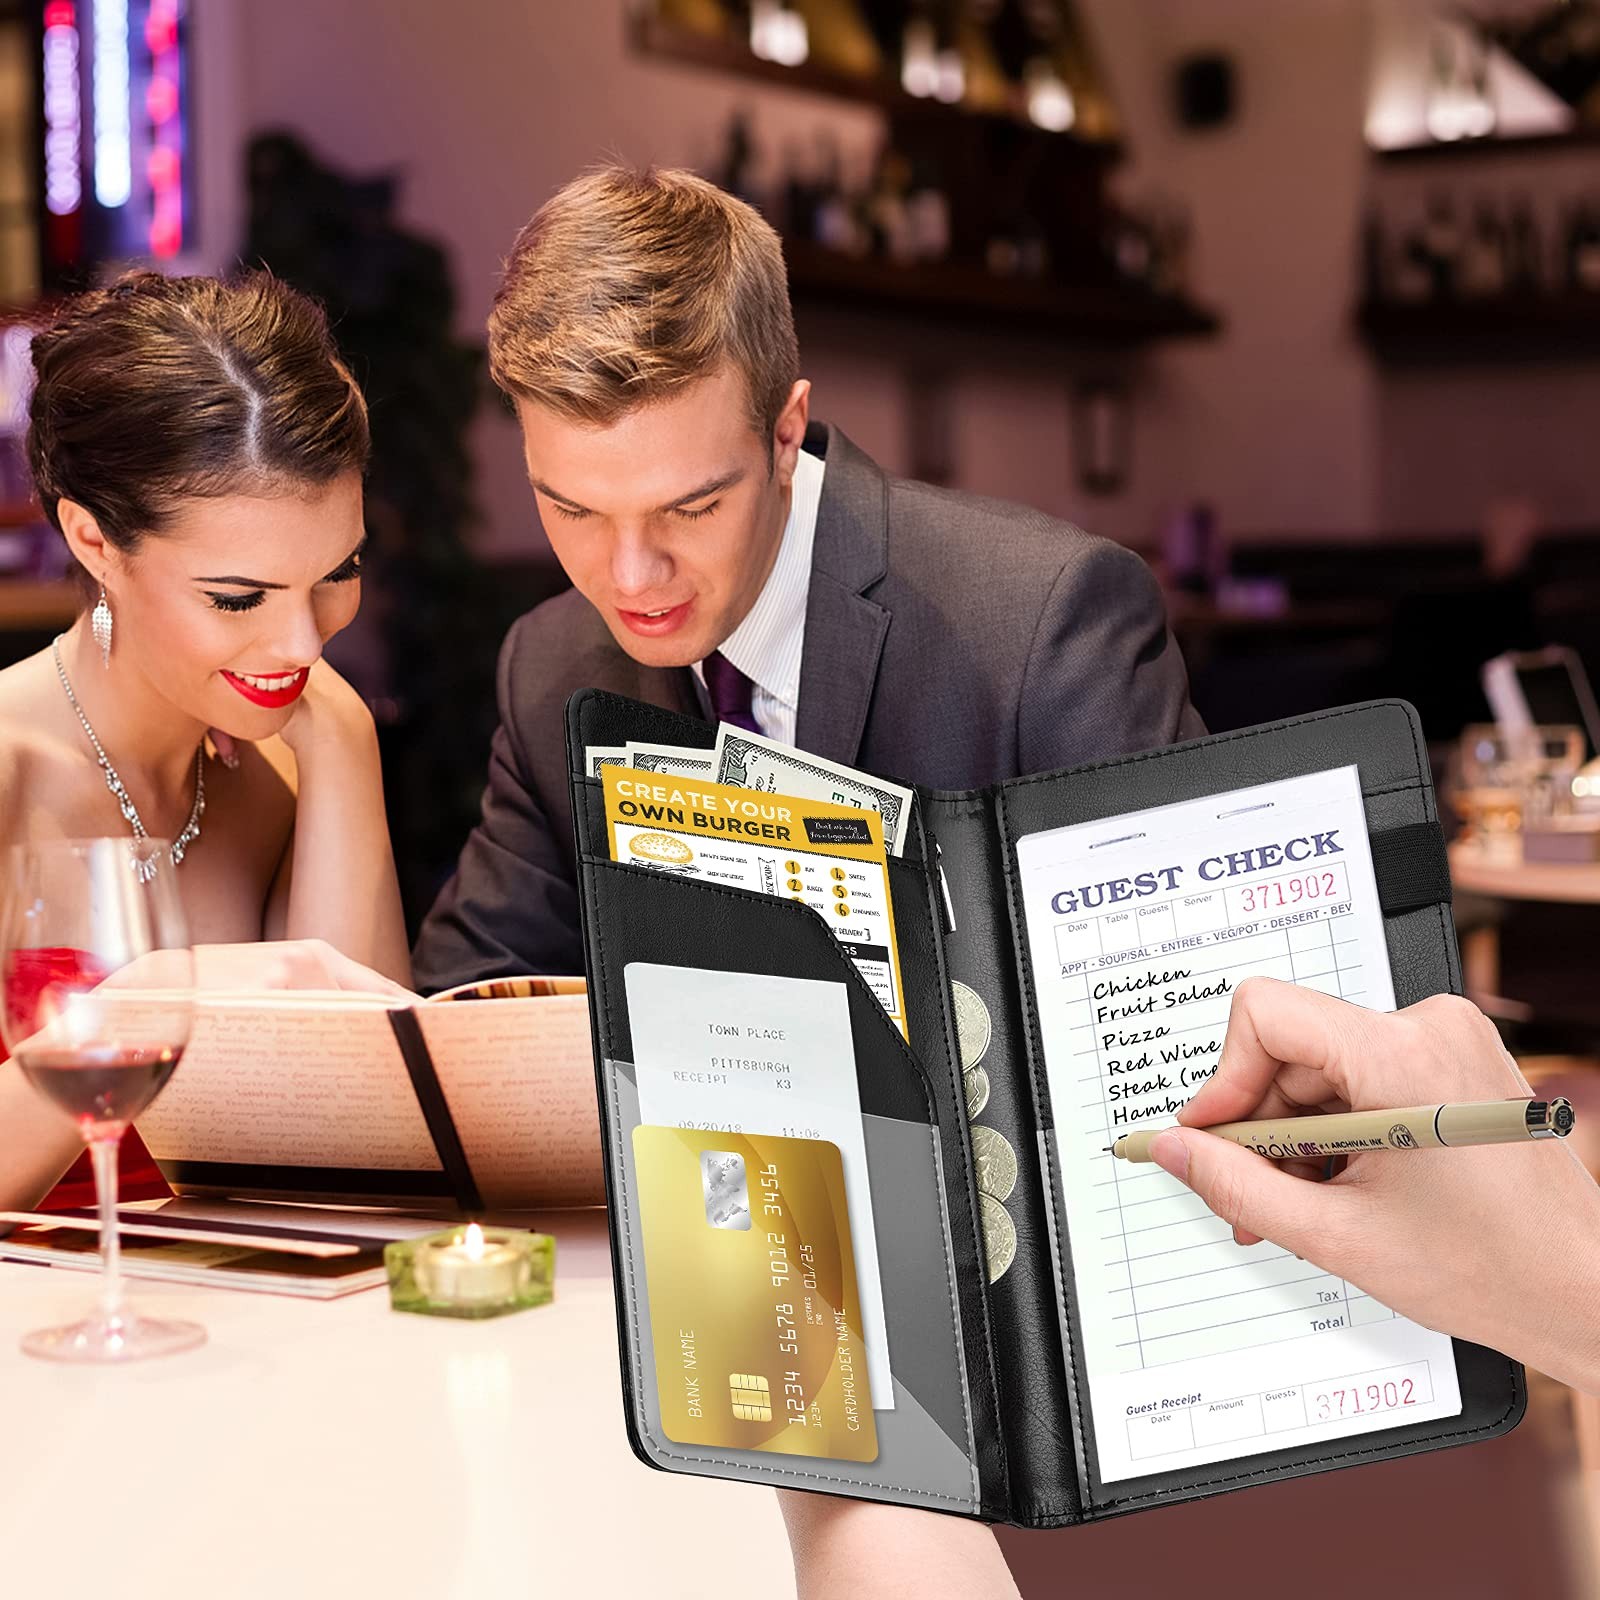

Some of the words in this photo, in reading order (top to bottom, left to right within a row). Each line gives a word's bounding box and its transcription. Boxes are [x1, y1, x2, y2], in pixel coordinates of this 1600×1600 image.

[616, 780, 718, 810] CREATE
[723, 797, 792, 823] YOUR
[618, 800, 685, 825] OWN
[693, 812, 792, 842] BURGER
[790, 861, 796, 874] 1
[835, 867, 843, 881] 4
[1051, 865, 1184, 915] GUEST
[1198, 829, 1345, 881] CHECK
[791, 879, 801, 892] 2
[836, 885, 844, 898] 5
[1240, 872, 1337, 912] 371902
[839, 903, 847, 917] 6
[1138, 904, 1170, 917] Guests
[1183, 894, 1213, 907] Server
[1067, 922, 1088, 933] Date
[1105, 913, 1129, 925] Table
[1061, 960, 1088, 976] APPT
[1098, 948, 1152, 967] SOUP/SAL
[1161, 935, 1204, 953] ENTREE
[1213, 923, 1260, 941] VEG/POT
[1270, 909, 1320, 929] DESSERT
[1330, 902, 1352, 916] BEV
[1093, 969, 1191, 1000] Chicken
[1097, 996, 1158, 1024] Fruit
[1164, 978, 1233, 1008] Salad
[708, 1023, 740, 1037] TOWN
[747, 1027, 786, 1041] PLACE
[1102, 1026, 1171, 1051] Pizza
[711, 1057, 791, 1073] PITTSBURGH
[1107, 1052, 1154, 1076] Red
[1160, 1040, 1222, 1064] Wine
[673, 1071, 728, 1085] RECEIPT
[775, 1079, 792, 1090] K3
[1108, 1074, 1173, 1102] Steak
[1299, 1141, 1322, 1157] 005
[1331, 1139, 1368, 1149] ARCHIVAL
[1369, 1137, 1384, 1146] INK
[760, 1164, 782, 1217] 3456
[767, 1232, 790, 1287] 9012
[799, 1244, 817, 1289] 01/25
[1316, 1290, 1340, 1303] Tax
[776, 1303, 798, 1355] 5678
[833, 1307, 850, 1341] NAME
[1310, 1316, 1344, 1332] Total
[679, 1328, 697, 1370] NAME
[684, 1376, 703, 1418] BANK
[784, 1370, 807, 1427] 1234
[838, 1346, 860, 1432] CARDHOLDER
[1265, 1390, 1297, 1402] Guests
[1316, 1378, 1416, 1419] 371902
[1126, 1401, 1157, 1416] Guest
[1161, 1393, 1202, 1409] Receipt
[1208, 1399, 1245, 1413] Amount
[1150, 1414, 1172, 1424] Date
